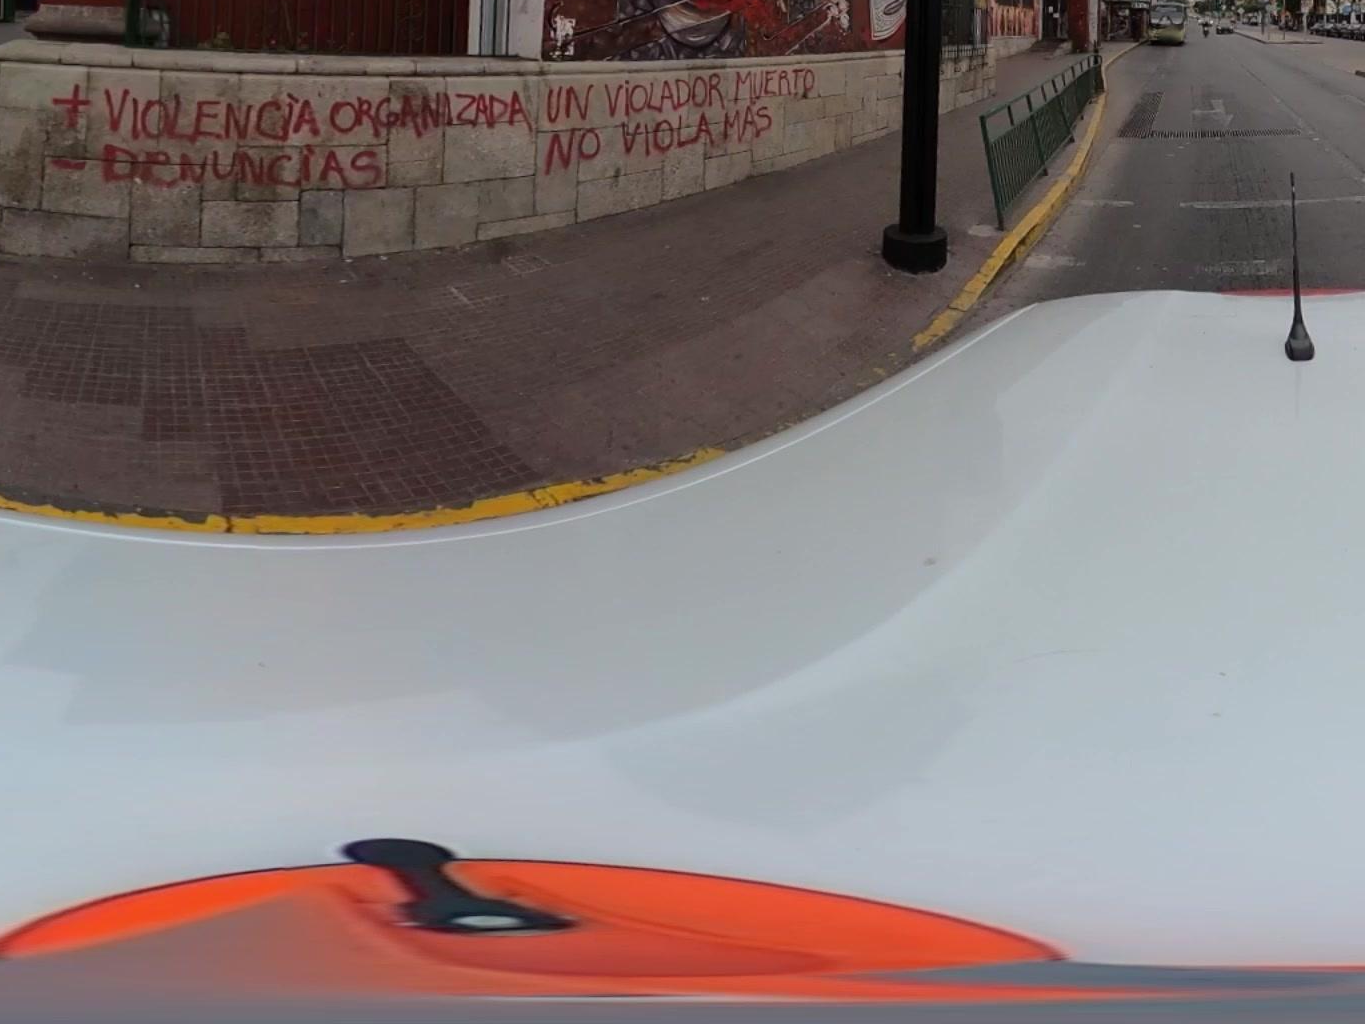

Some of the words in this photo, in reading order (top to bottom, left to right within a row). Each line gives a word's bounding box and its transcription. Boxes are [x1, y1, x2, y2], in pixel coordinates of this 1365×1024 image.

[329, 91, 534, 138] ORGANIZADA
[546, 84, 594, 123] UN
[735, 68, 815, 104] MUERTO
[102, 143, 381, 188] DENUNCIAS
[544, 127, 600, 175] NO
[621, 112, 714, 157] VIOLA
